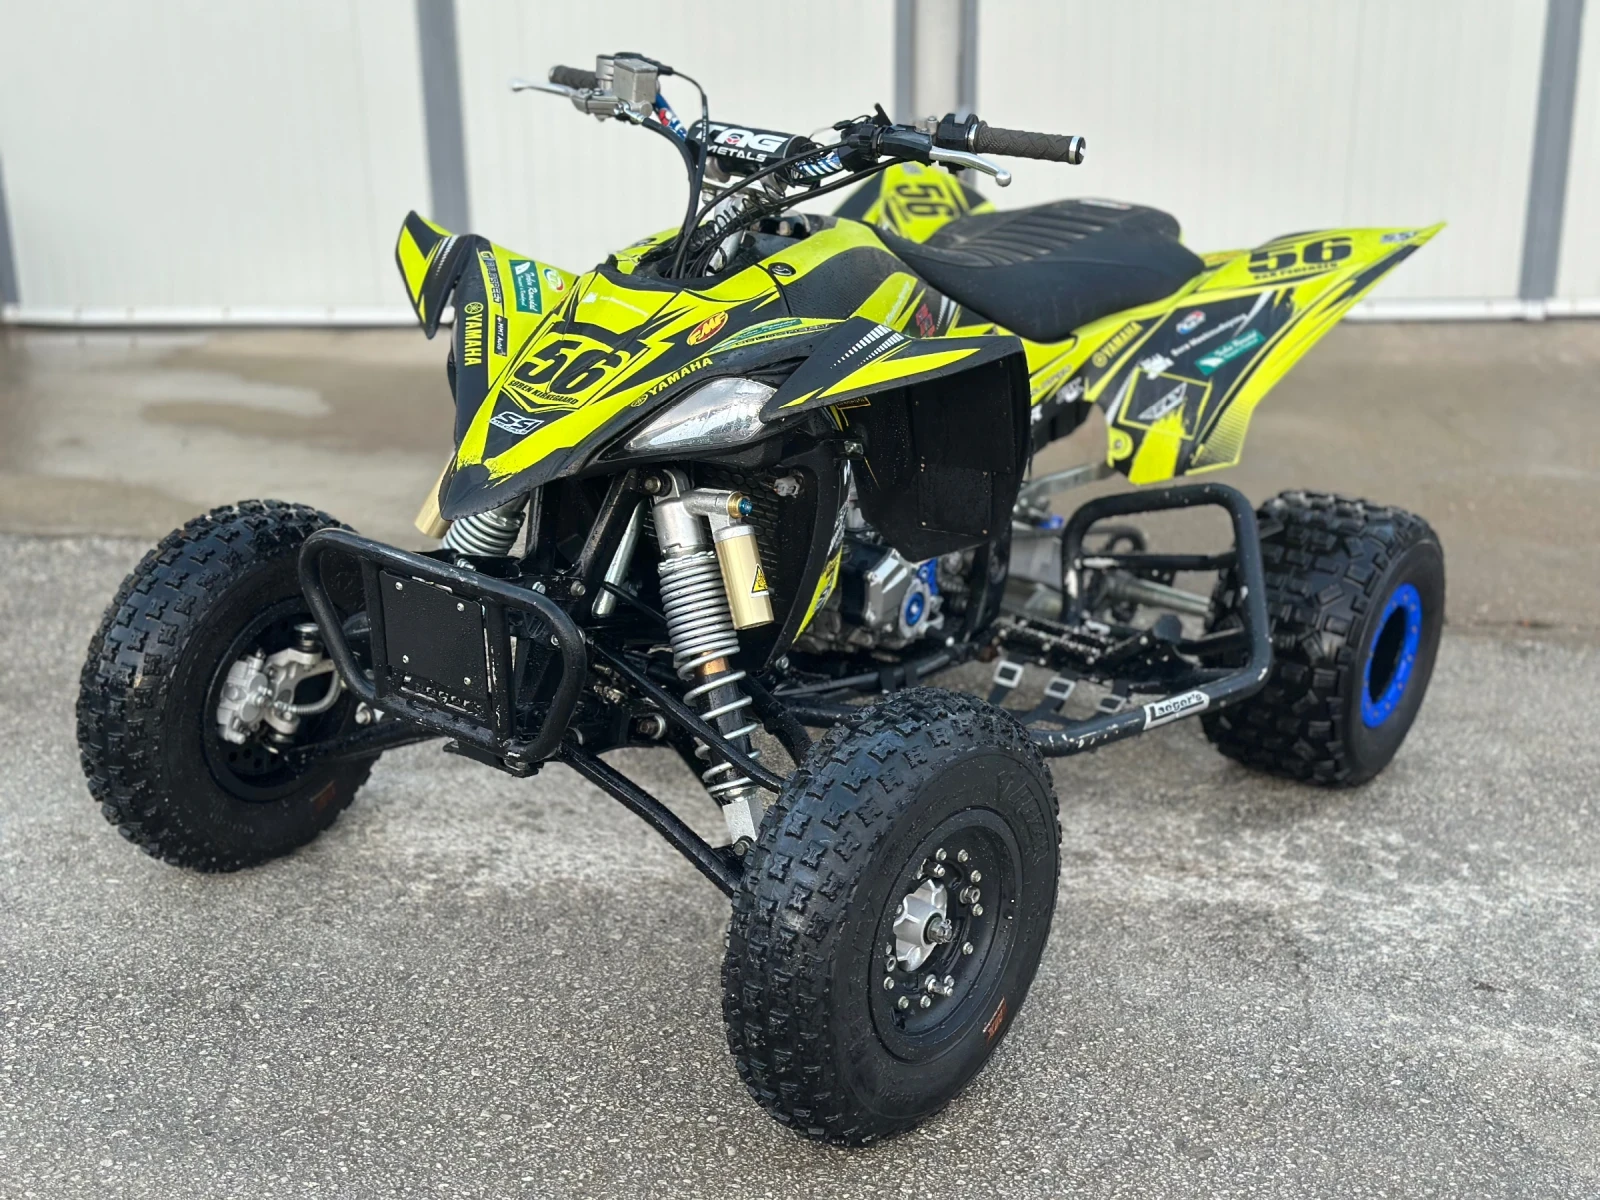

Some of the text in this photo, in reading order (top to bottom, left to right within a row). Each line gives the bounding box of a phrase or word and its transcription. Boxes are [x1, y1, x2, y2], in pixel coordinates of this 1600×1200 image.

[696, 122, 789, 153] TAG
[1248, 237, 1352, 273] 56
[464, 314, 483, 366] YAMAHA
[689, 310, 726, 345] FMF
[1102, 321, 1143, 358] YAMAHA
[513, 341, 623, 395] 56
[648, 357, 713, 396] YAMAHA
